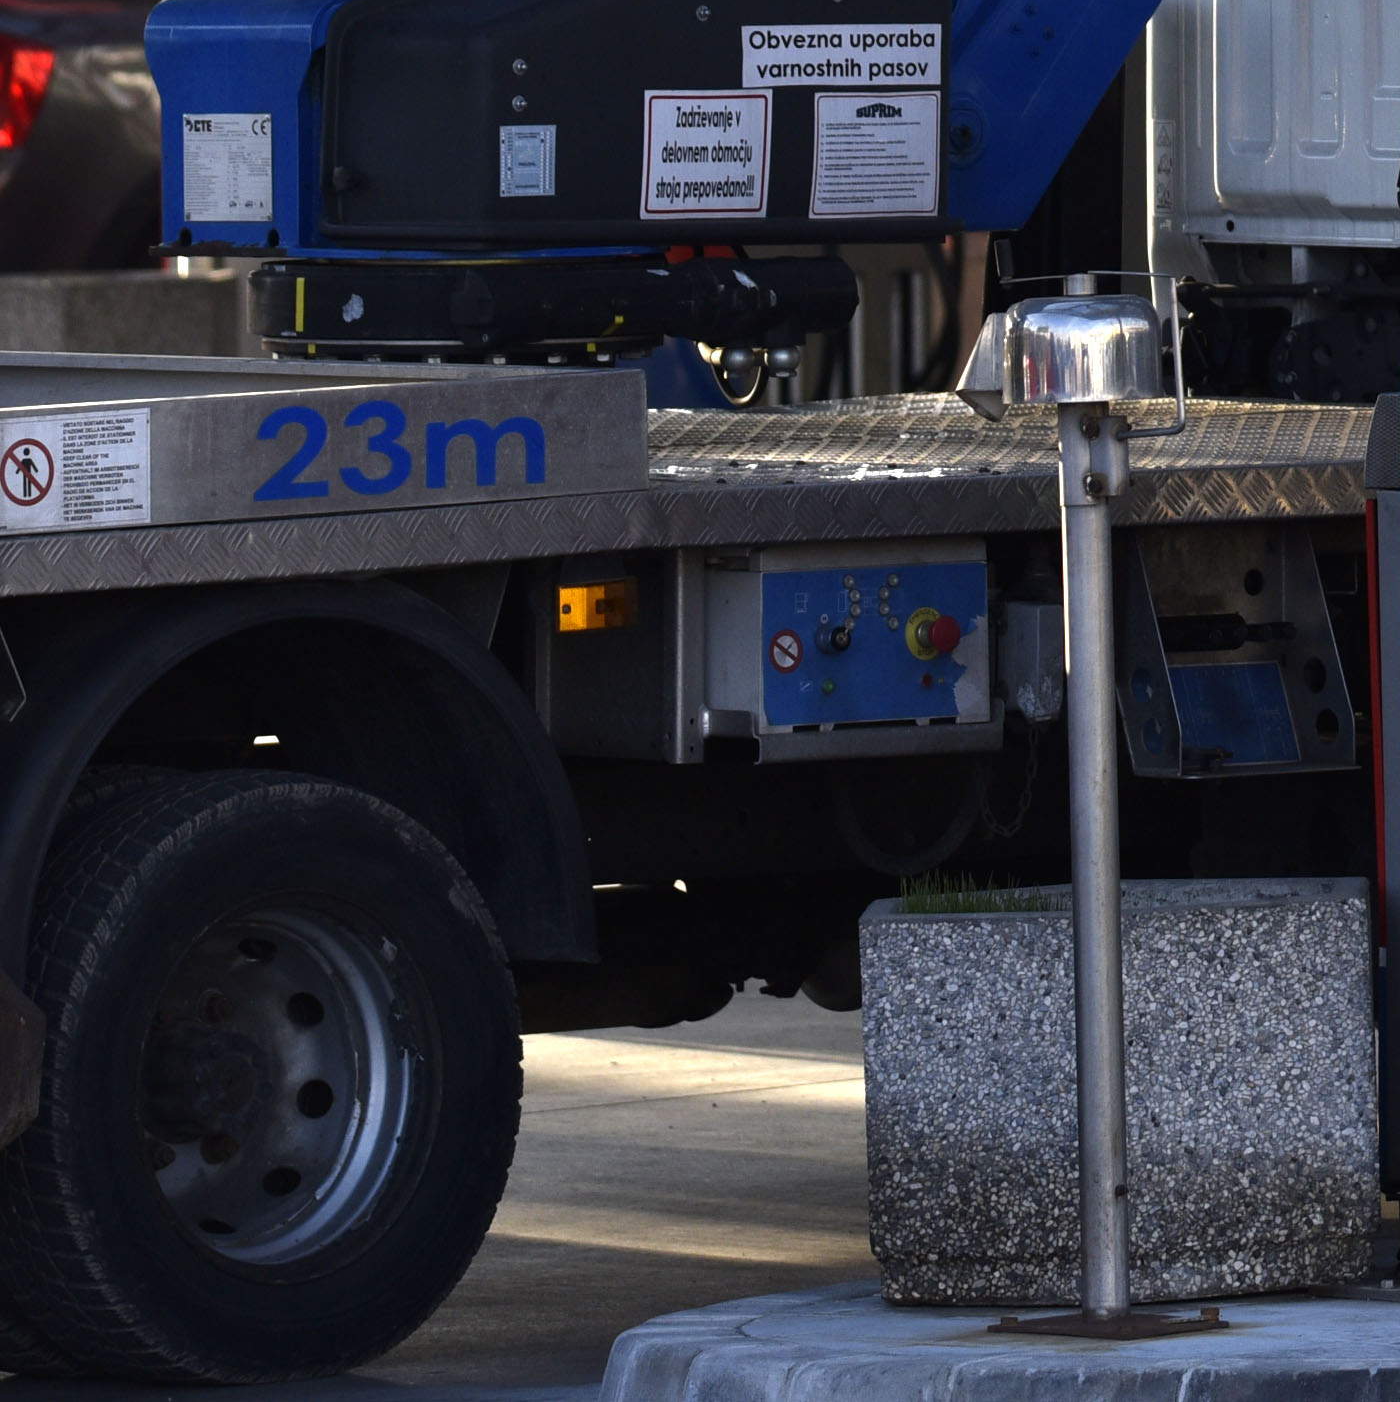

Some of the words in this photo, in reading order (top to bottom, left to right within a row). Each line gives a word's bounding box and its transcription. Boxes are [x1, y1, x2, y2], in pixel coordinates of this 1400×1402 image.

[749, 30, 843, 50] Obvezna
[850, 29, 936, 52] uporaba
[757, 58, 862, 79] varnostnih
[869, 62, 928, 81] pasov
[676, 104, 733, 133] Zadrževanje
[736, 110, 741, 127] v
[856, 102, 902, 118] SUPRIM
[194, 120, 212, 132] CTE
[662, 140, 709, 164] delovnem
[711, 138, 752, 168] območju
[656, 176, 681, 204] stroja
[682, 174, 755, 204] prepovedano!!!
[253, 400, 546, 501] 23m
